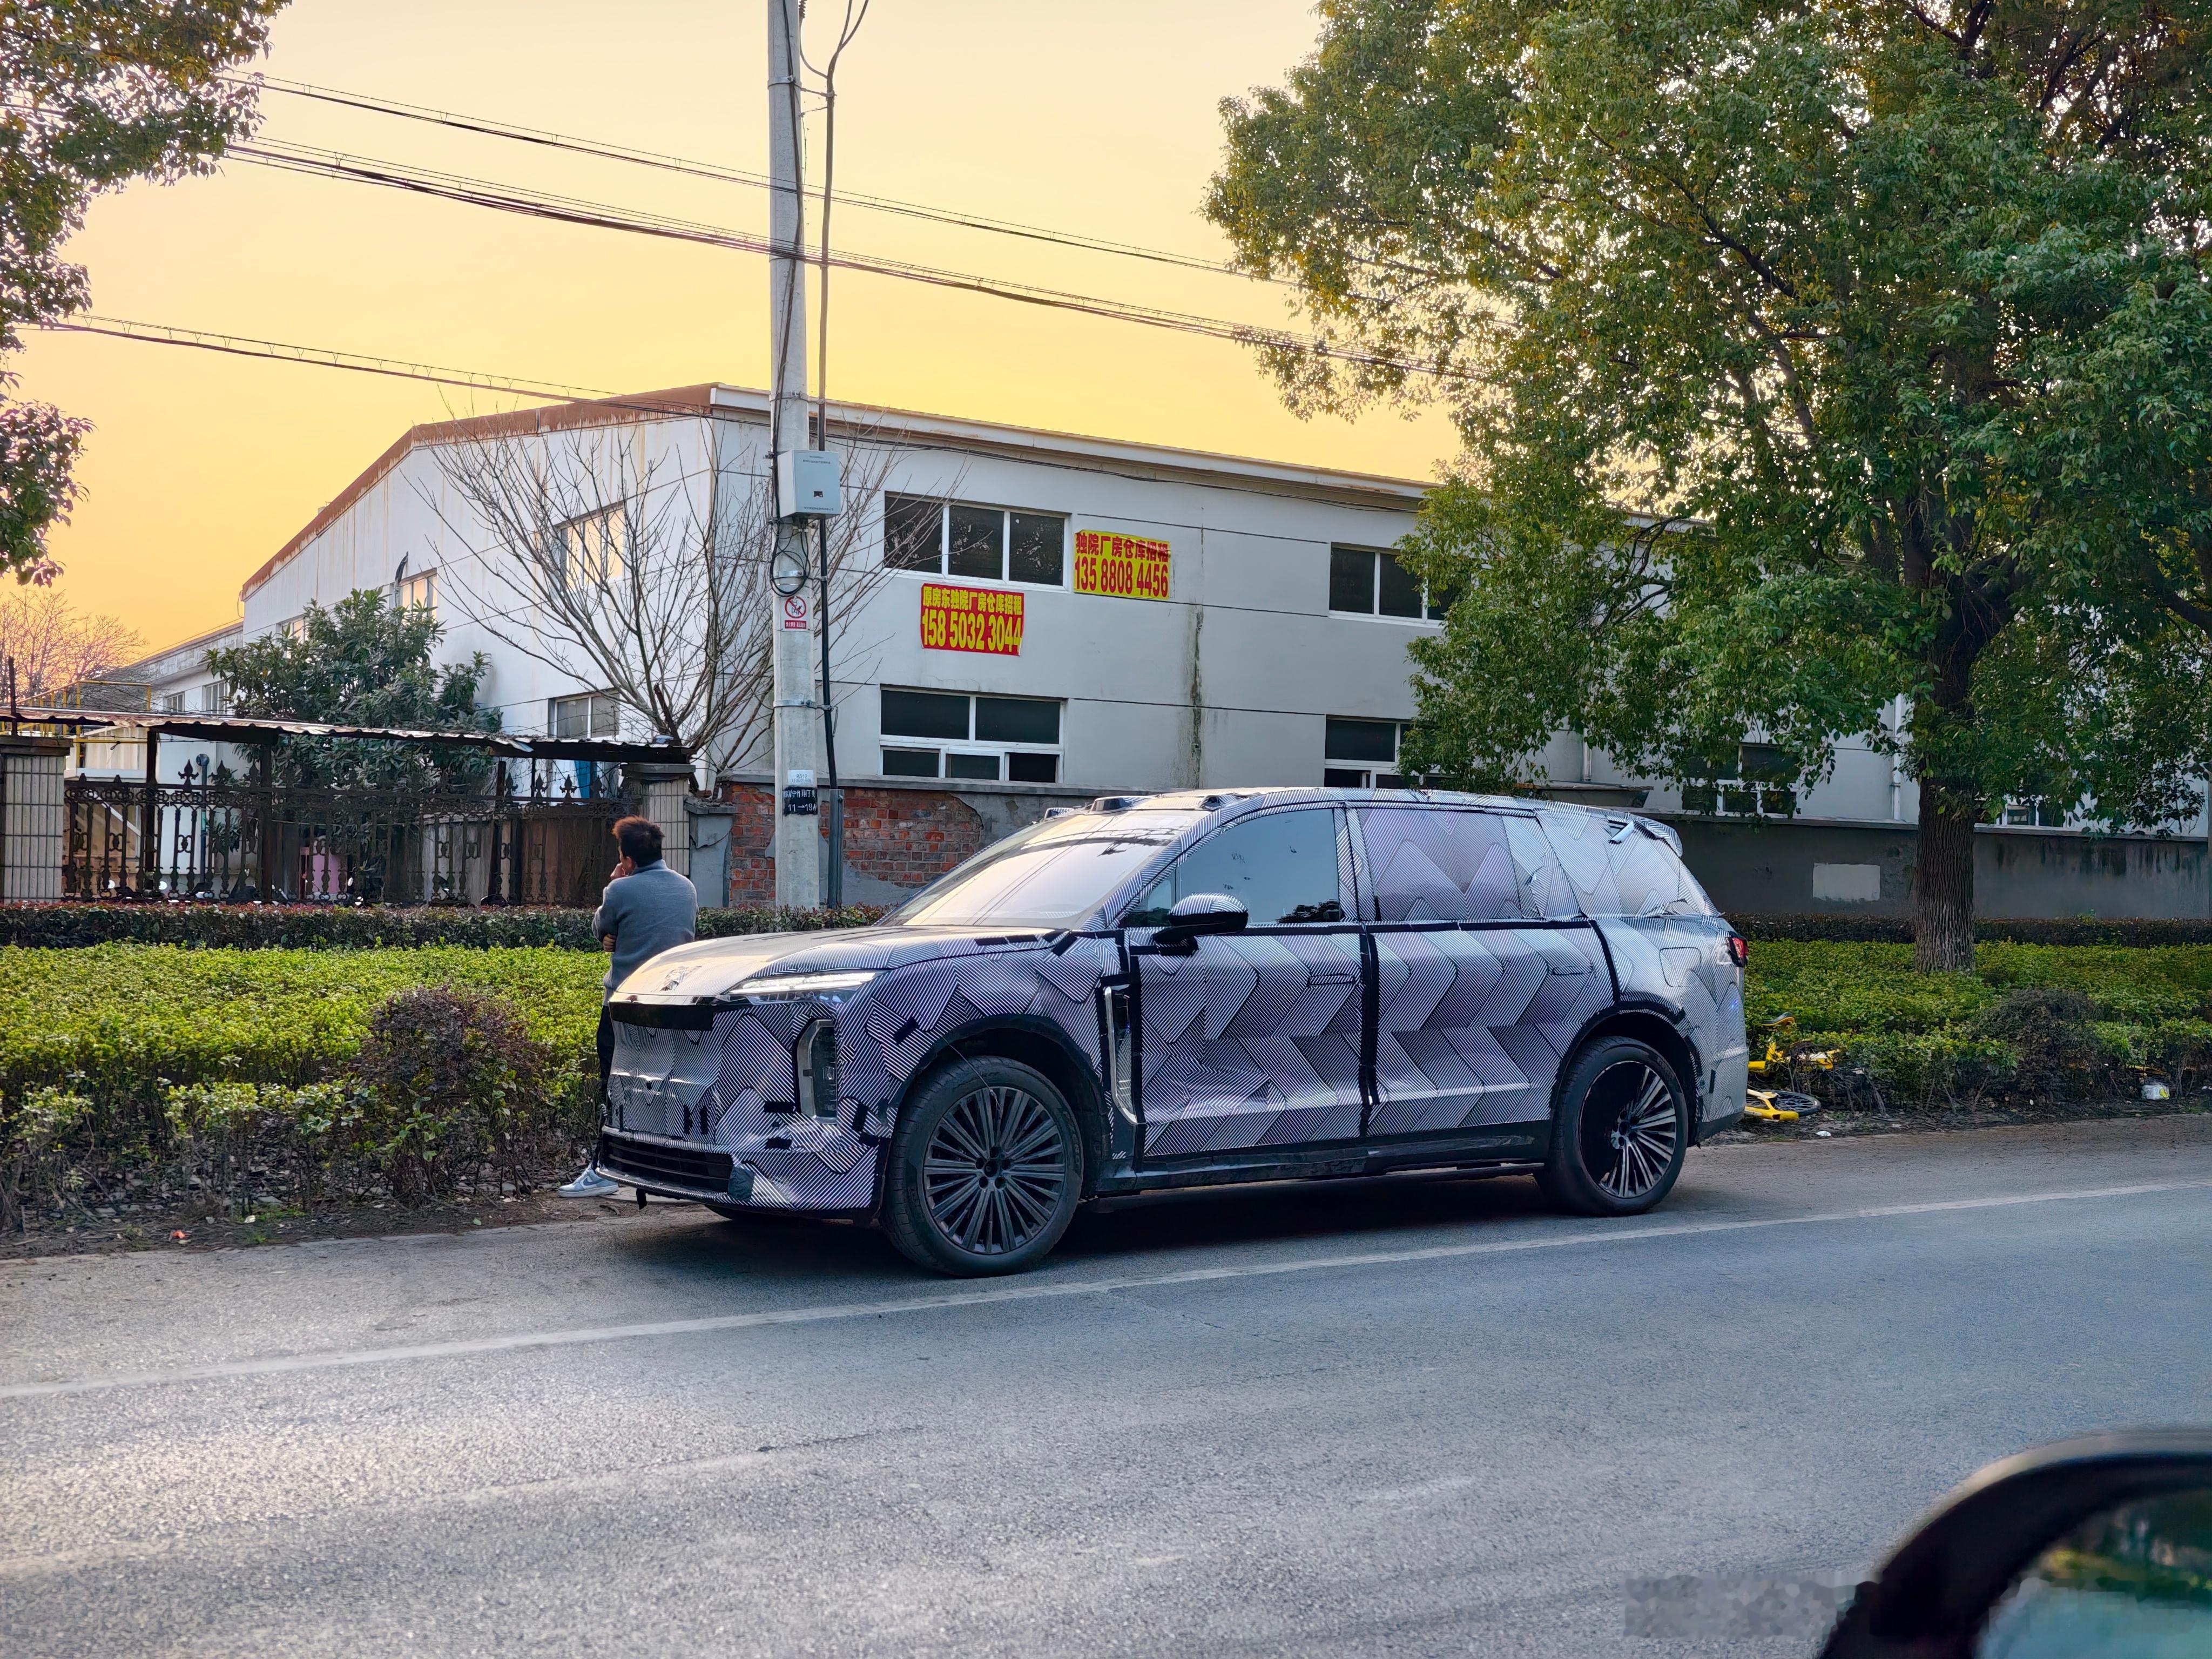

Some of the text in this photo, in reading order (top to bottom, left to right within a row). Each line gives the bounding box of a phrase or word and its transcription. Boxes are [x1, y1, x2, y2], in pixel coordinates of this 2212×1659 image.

[1076, 532, 1169, 562] 独院厂房仓库招租
[1075, 555, 1168, 597] 135 8808 4456
[923, 586, 1022, 615] 原房东独院厂房仓库招租
[922, 608, 1021, 652] 158 5032 3044
